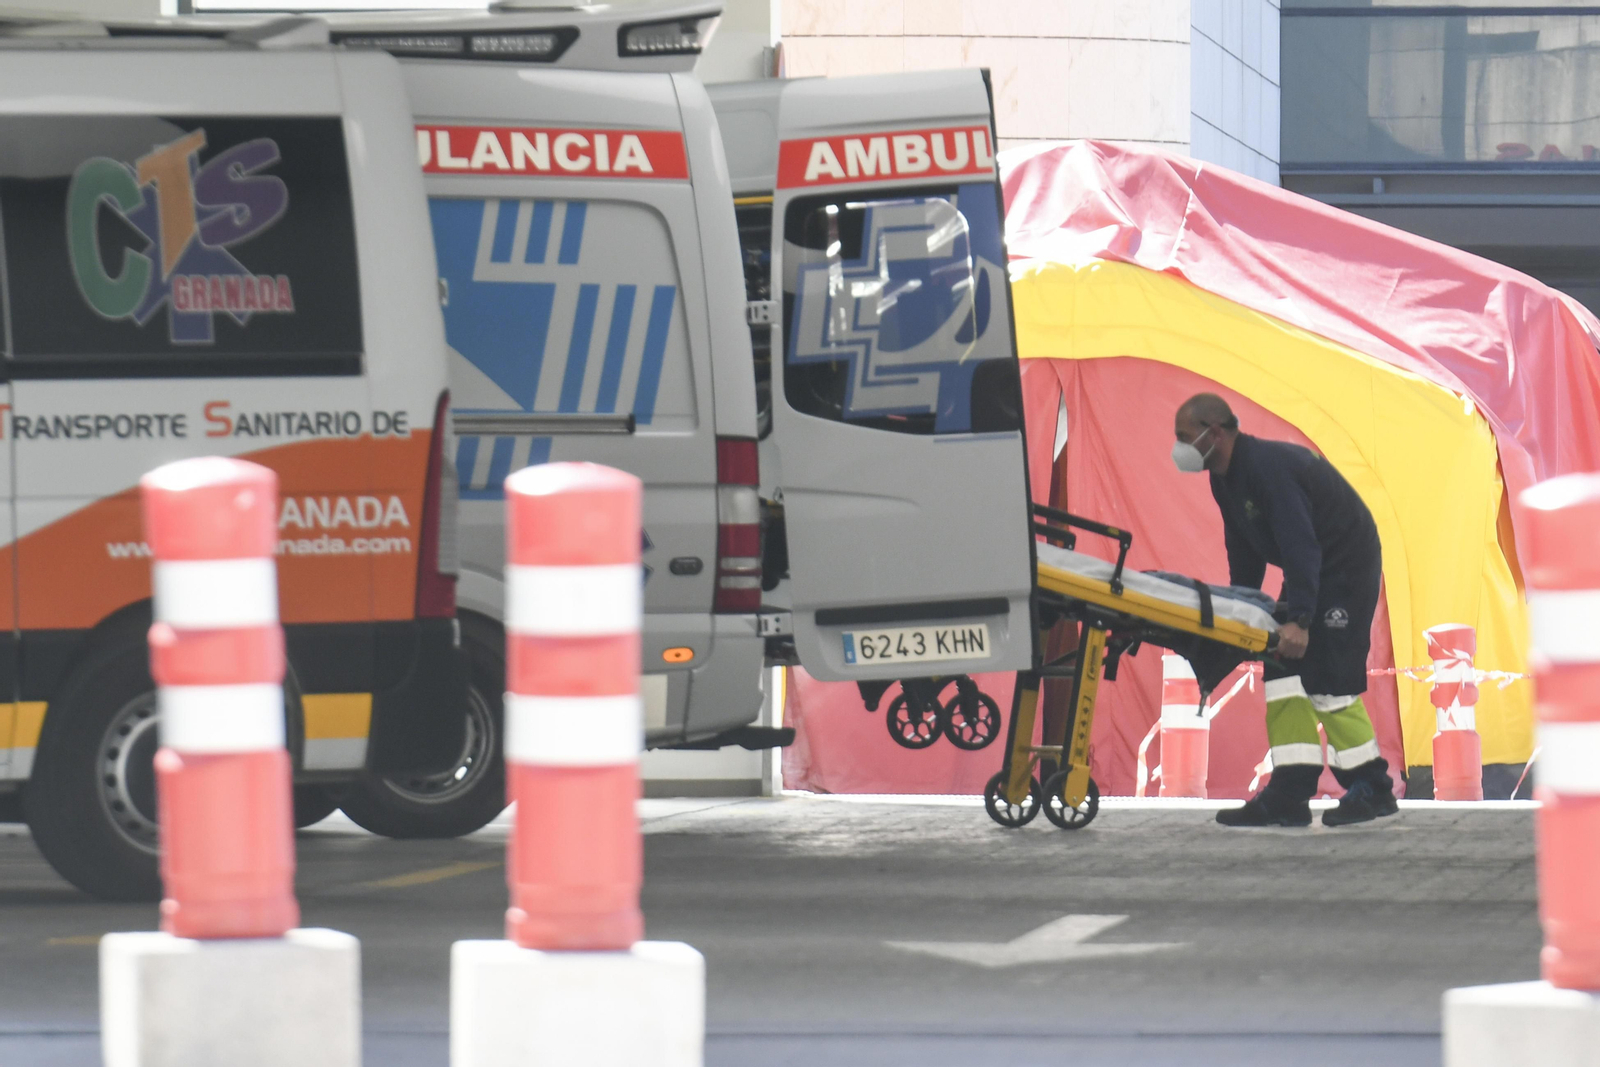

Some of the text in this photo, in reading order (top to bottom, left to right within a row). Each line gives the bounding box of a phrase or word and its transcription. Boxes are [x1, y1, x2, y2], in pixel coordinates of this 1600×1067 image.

[804, 130, 993, 181] AMBUL
[67, 127, 289, 319] CTS
[172, 273, 295, 313] GRANADA
[203, 400, 362, 437] SANITARIO
[372, 410, 409, 436] DE
[860, 628, 986, 659] 6243 KHN
